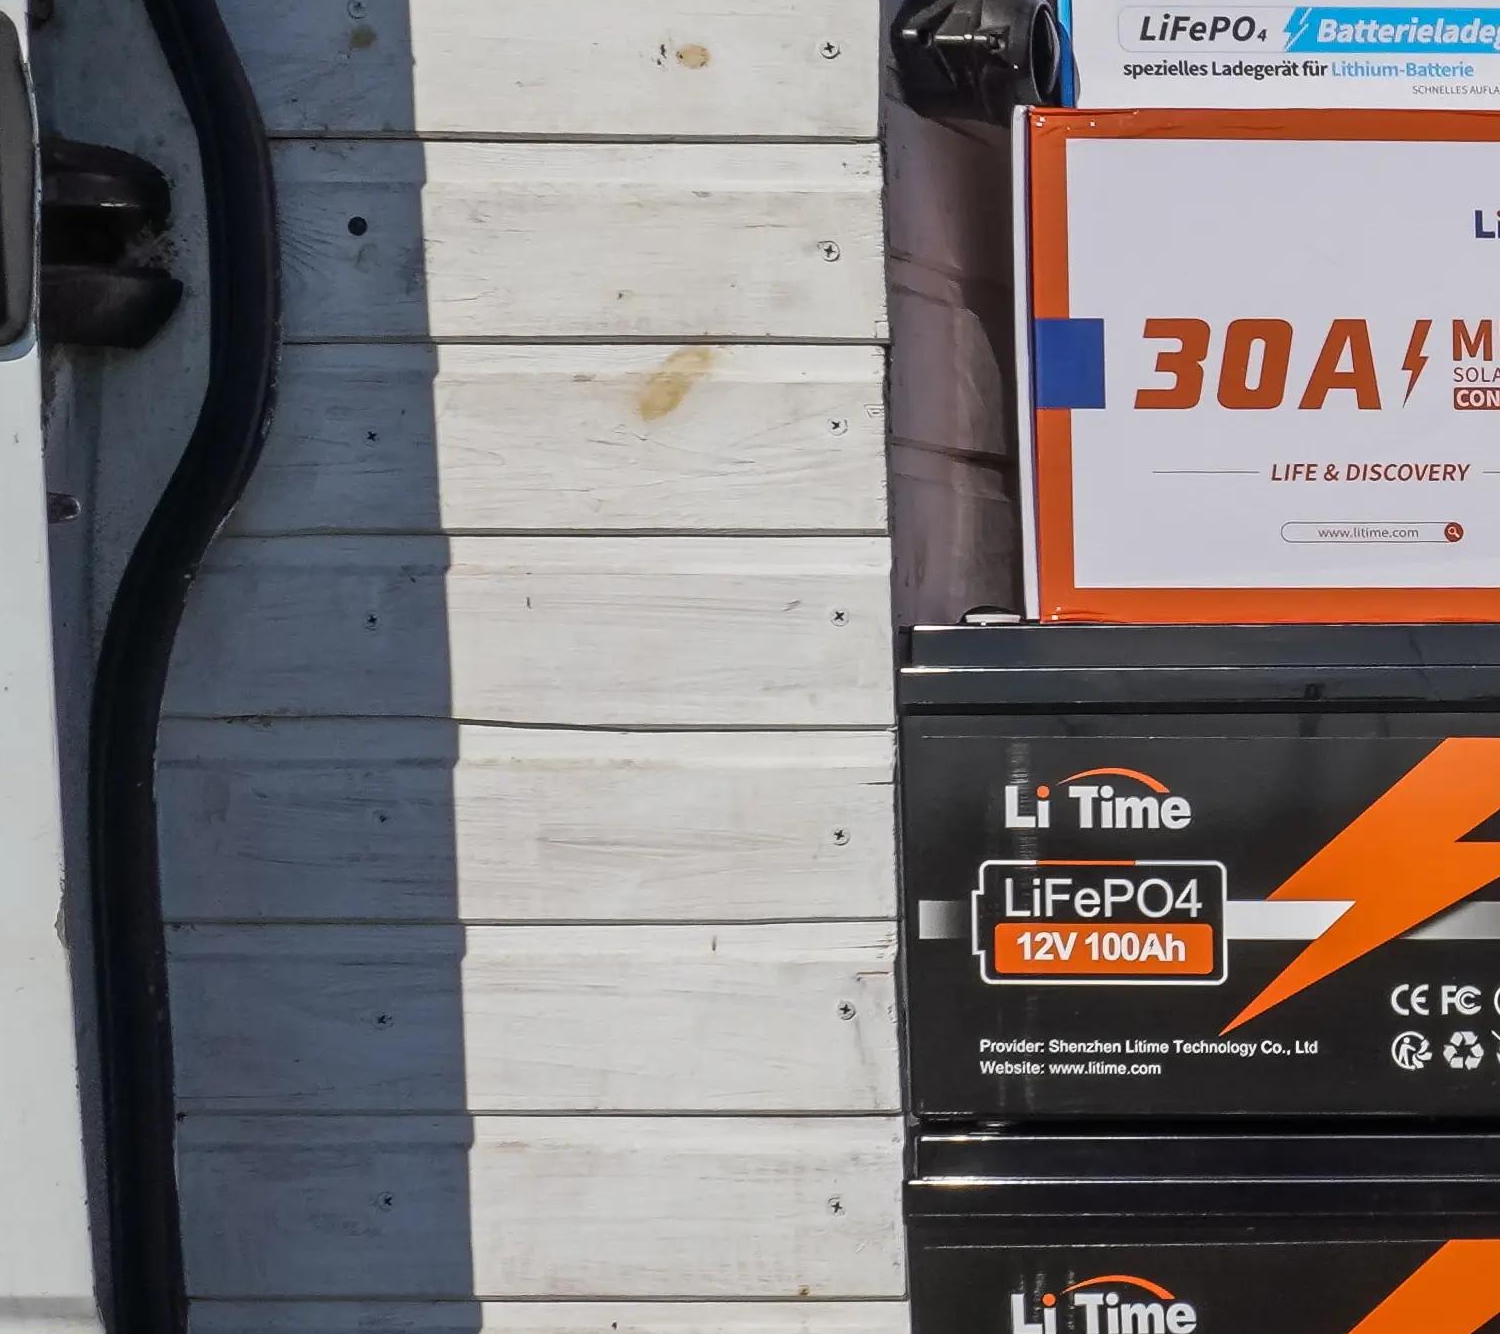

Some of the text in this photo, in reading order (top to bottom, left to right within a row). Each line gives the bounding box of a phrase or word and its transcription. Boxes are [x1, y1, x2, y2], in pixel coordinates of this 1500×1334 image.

[1123, 60, 1474, 81] spezielles Ladegerät für Lithium-Batterie
[1412, 85, 1468, 96] SCHNELLES
[1134, 318, 1381, 410] 30A
[1271, 463, 1471, 482] LIFE & DISCOVERY
[1318, 526, 1419, 539] www.litime.com
[1005, 785, 1192, 830] Li Time
[1005, 879, 1202, 918] LiFePO4
[1016, 932, 1186, 962] 12V 100Ah
[1391, 984, 1429, 1015] CE
[980, 1039, 1318, 1058] Provider: Shenzhen Litime Technology Co., Ltd
[980, 1061, 1161, 1076] Website: www.litime.com
